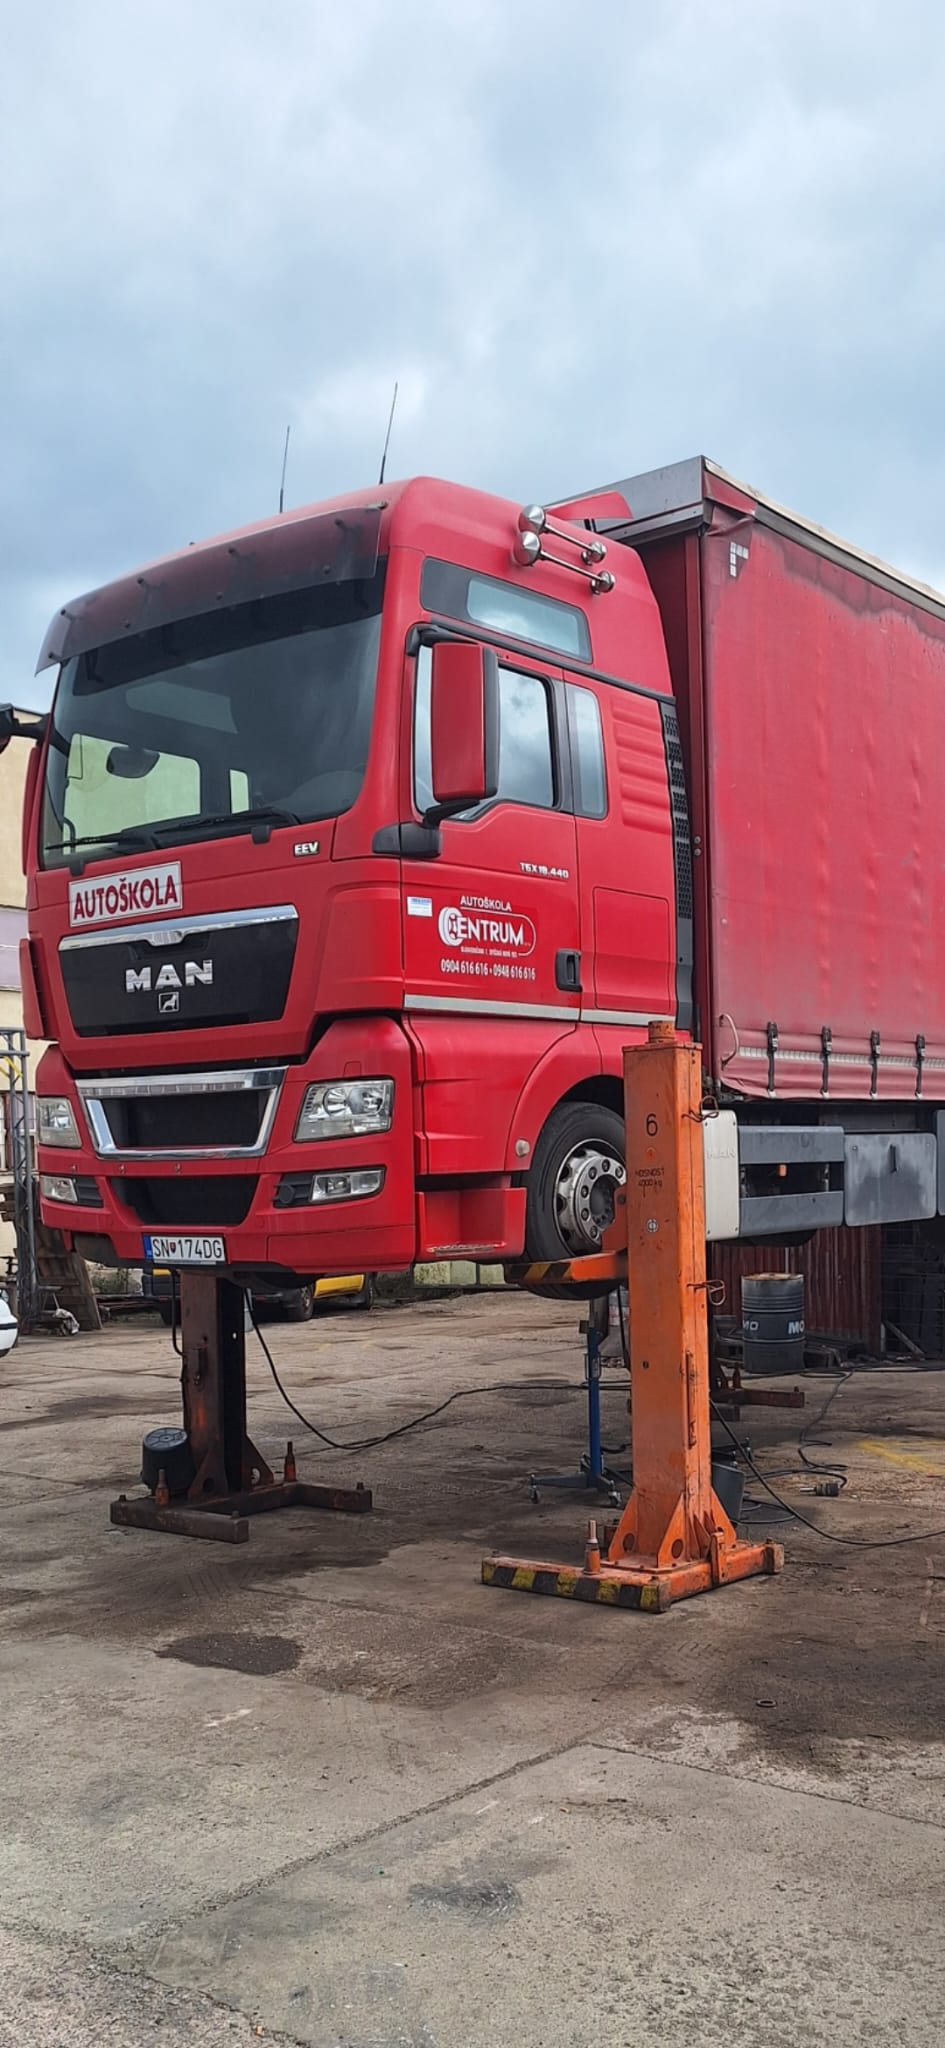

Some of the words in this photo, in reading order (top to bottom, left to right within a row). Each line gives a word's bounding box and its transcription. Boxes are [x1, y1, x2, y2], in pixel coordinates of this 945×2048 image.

[294, 842, 319, 855] EEV
[73, 877, 178, 920] AUTOŠKOLA
[460, 895, 512, 912] AUTOŠKOLA
[125, 960, 213, 993] MAN
[441, 958, 459, 973] 0904
[461, 960, 474, 975] 616
[475, 961, 488, 976] 616
[493, 963, 509, 977] 0948
[511, 965, 522, 979] 616
[523, 967, 535, 980] 616
[646, 1112, 658, 1137] 6
[152, 1239, 170, 1257] SN
[178, 1240, 222, 1258] 174DG
